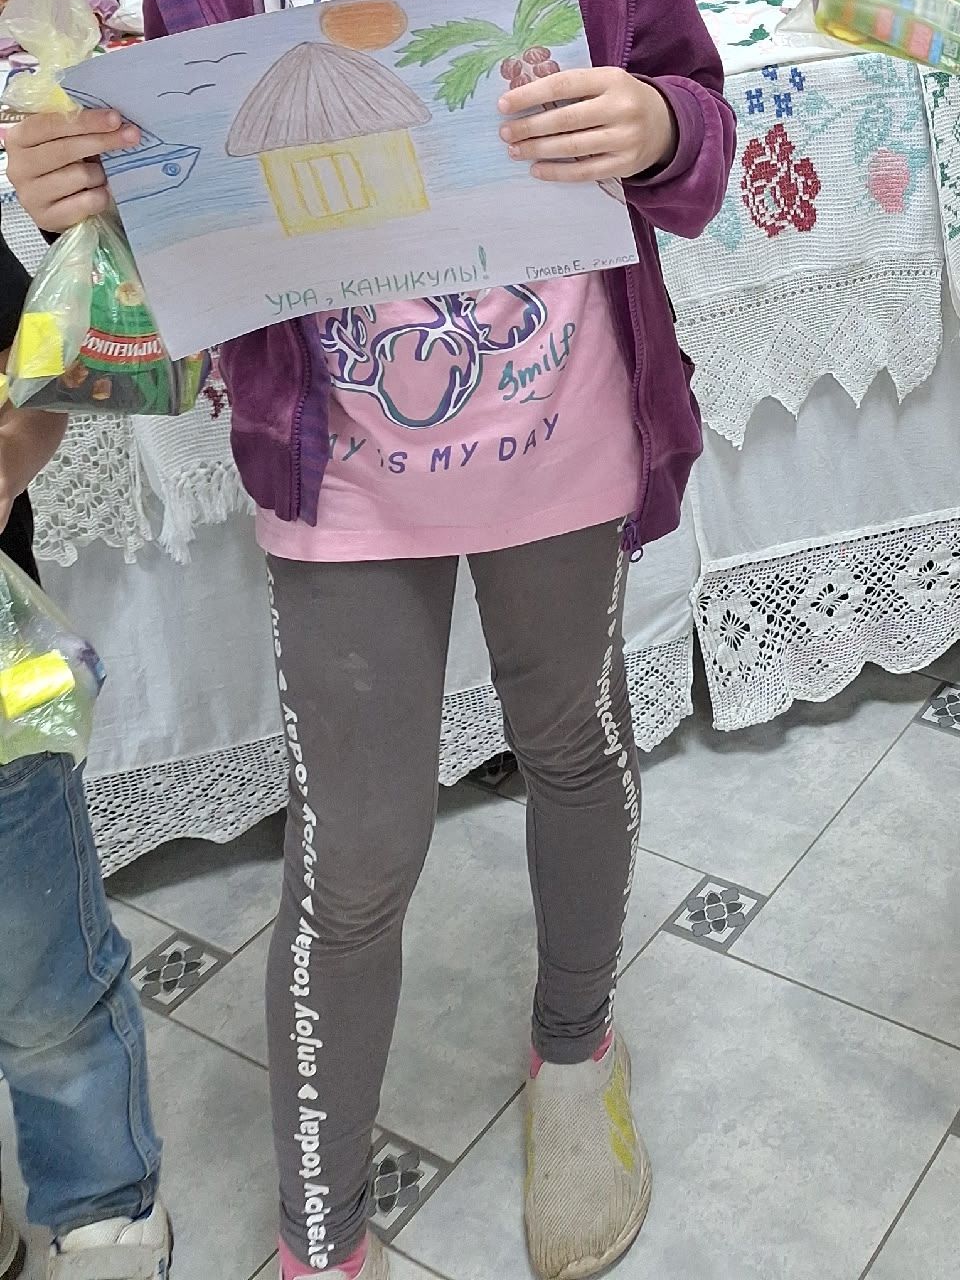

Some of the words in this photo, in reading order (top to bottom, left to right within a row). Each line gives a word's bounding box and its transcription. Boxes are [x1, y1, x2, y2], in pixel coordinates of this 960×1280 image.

[265, 287, 333, 317] УРА,
[340, 245, 490, 299] КАНИКУЛЫ!
[430, 441, 480, 473] MY
[498, 413, 560, 462] DAY
[289, 916, 320, 997] today
[288, 1001, 324, 1078] enjoy
[294, 1104, 328, 1180] today
